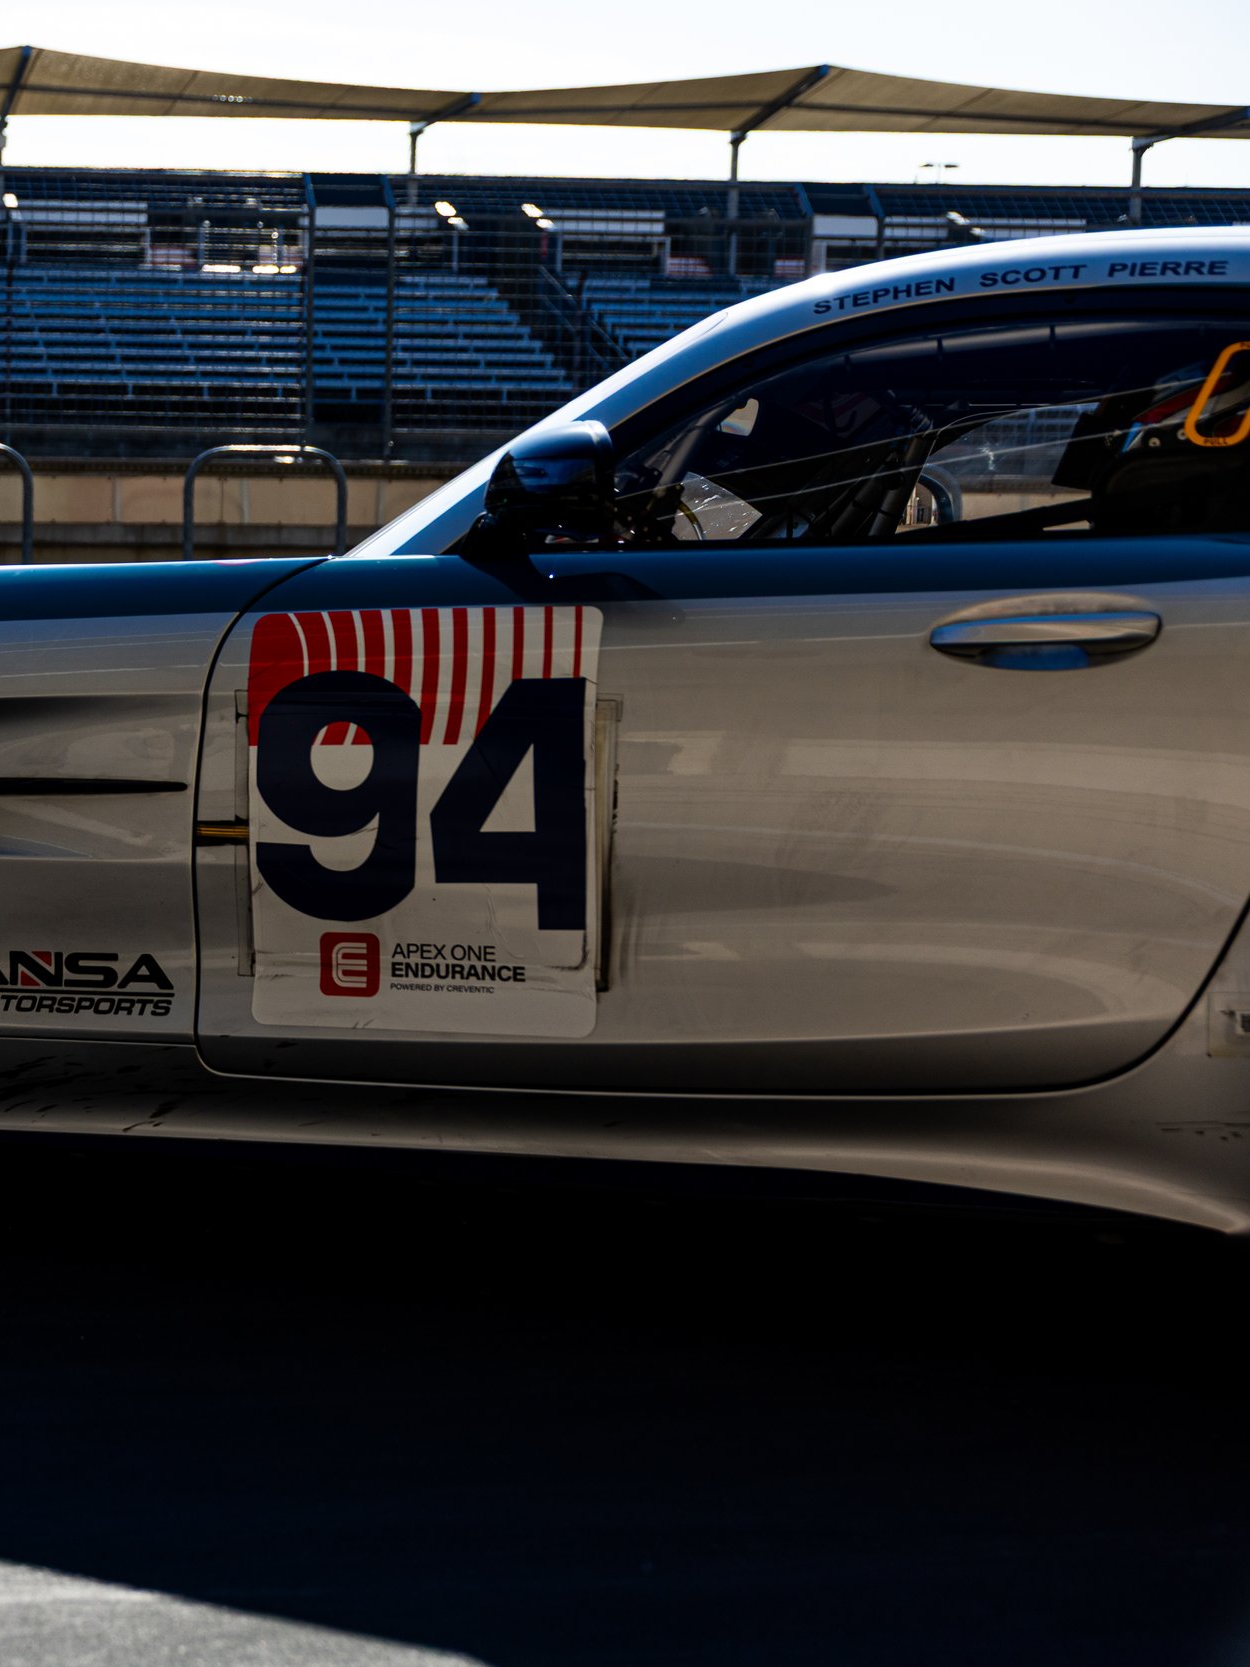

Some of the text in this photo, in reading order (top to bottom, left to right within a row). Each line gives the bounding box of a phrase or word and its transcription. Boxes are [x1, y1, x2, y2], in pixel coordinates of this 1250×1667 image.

[813, 260, 1230, 315] STEPHEN SCOTT PIERRE
[256, 670, 587, 930] 94
[391, 943, 497, 962] APEX ONE
[390, 961, 526, 983] ENDURANCE
[390, 982, 495, 994] POWERED BY CREVENTIC
